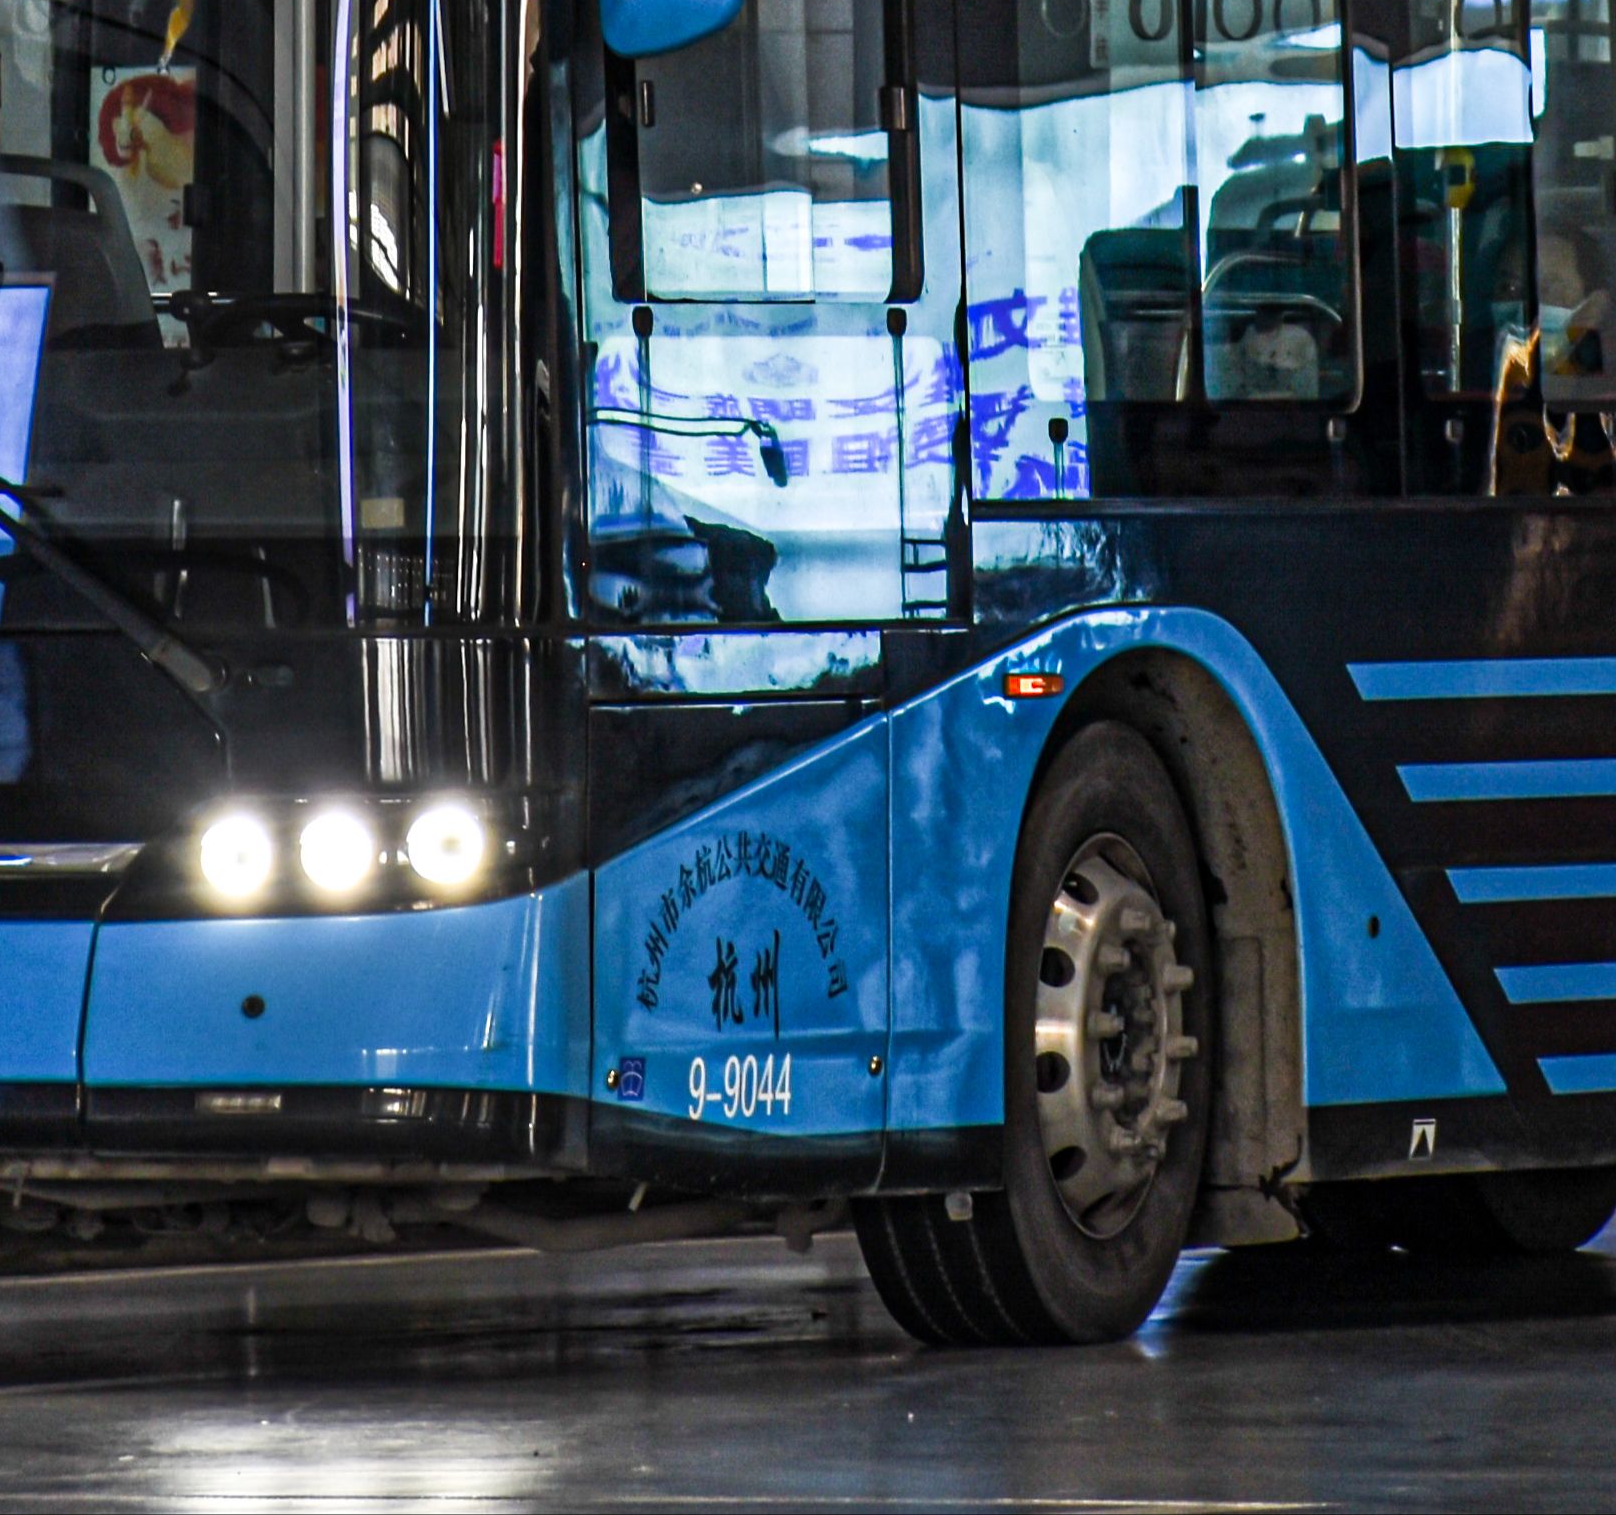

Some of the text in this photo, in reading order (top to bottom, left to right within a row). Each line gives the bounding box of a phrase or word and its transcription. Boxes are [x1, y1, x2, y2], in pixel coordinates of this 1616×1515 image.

[636, 830, 848, 1013] 杭州市余杭公共交通有限公司
[708, 929, 779, 1041] 杭州
[688, 1052, 792, 1121] 9-9044
